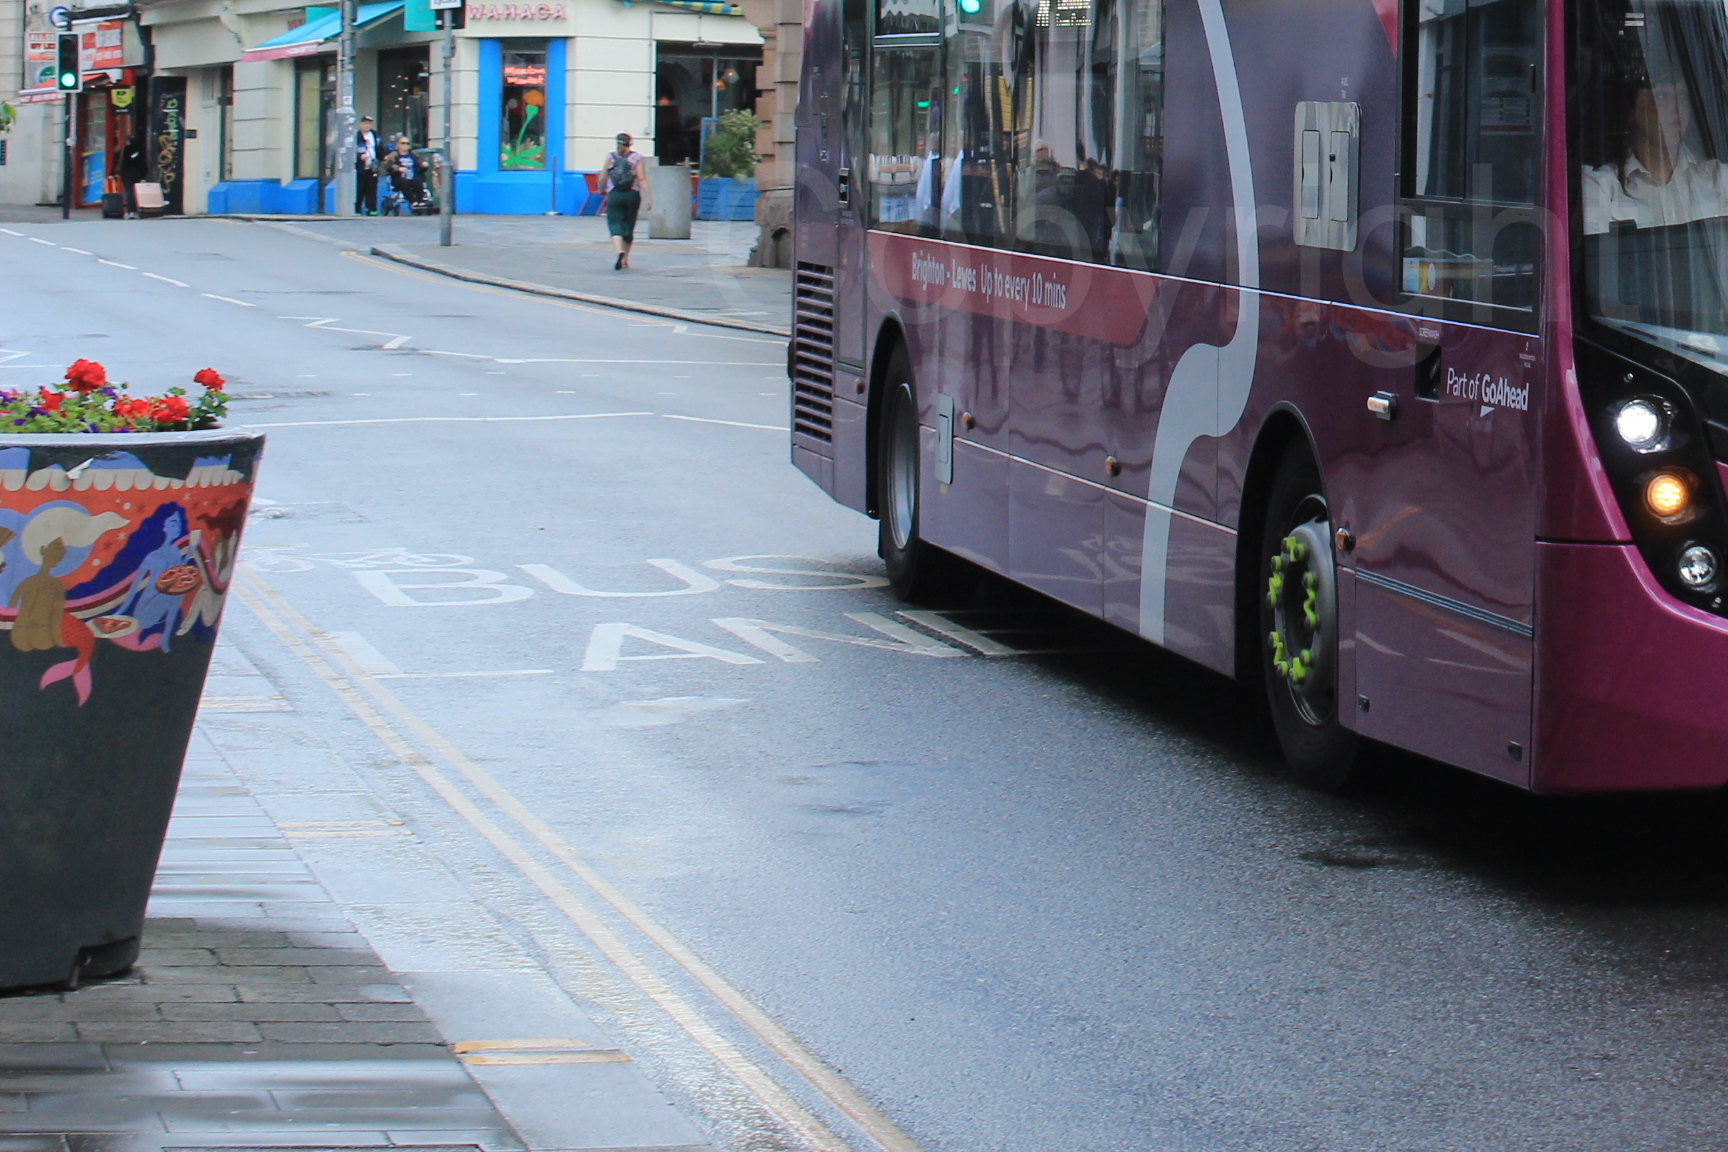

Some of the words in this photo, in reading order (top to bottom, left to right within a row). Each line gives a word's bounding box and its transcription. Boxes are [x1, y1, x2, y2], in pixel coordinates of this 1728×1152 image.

[466, 3, 568, 21] WAHACA
[912, 250, 945, 291] Brighton
[952, 258, 977, 292] Lewes
[981, 263, 992, 303] Up
[995, 268, 1004, 298] to
[1005, 274, 1030, 312] every
[1032, 272, 1043, 304] 10
[1044, 272, 1067, 310] mins
[1446, 367, 1466, 398] Part
[1468, 373, 1481, 401] of
[1481, 374, 1530, 411] GoAhead
[351, 554, 890, 606] BUS
